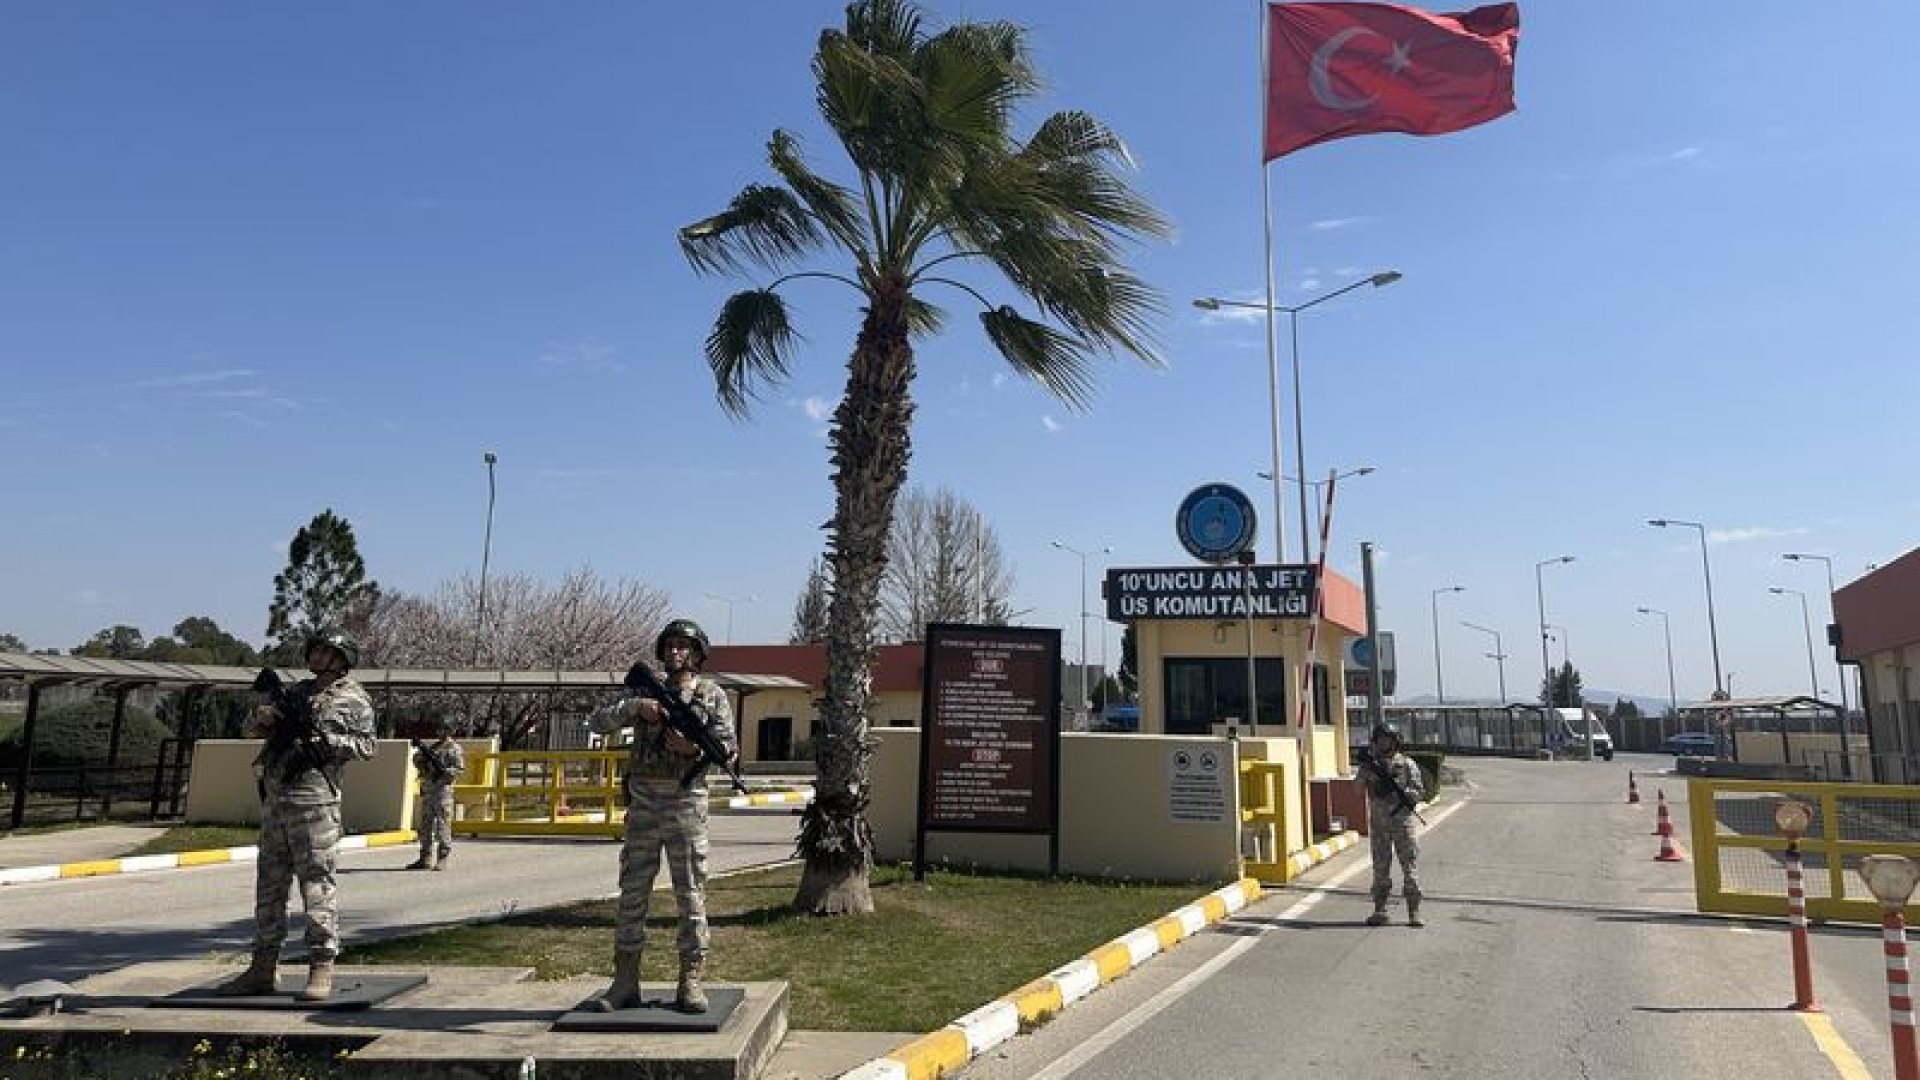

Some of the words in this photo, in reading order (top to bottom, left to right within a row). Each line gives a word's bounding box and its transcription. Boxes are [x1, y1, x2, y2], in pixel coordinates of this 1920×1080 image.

[1211, 571, 1258, 589] ANA
[1266, 570, 1307, 588] JET
[1120, 594, 1149, 616] ÜS
[1154, 590, 1306, 615] KOMUTANLIĞI
